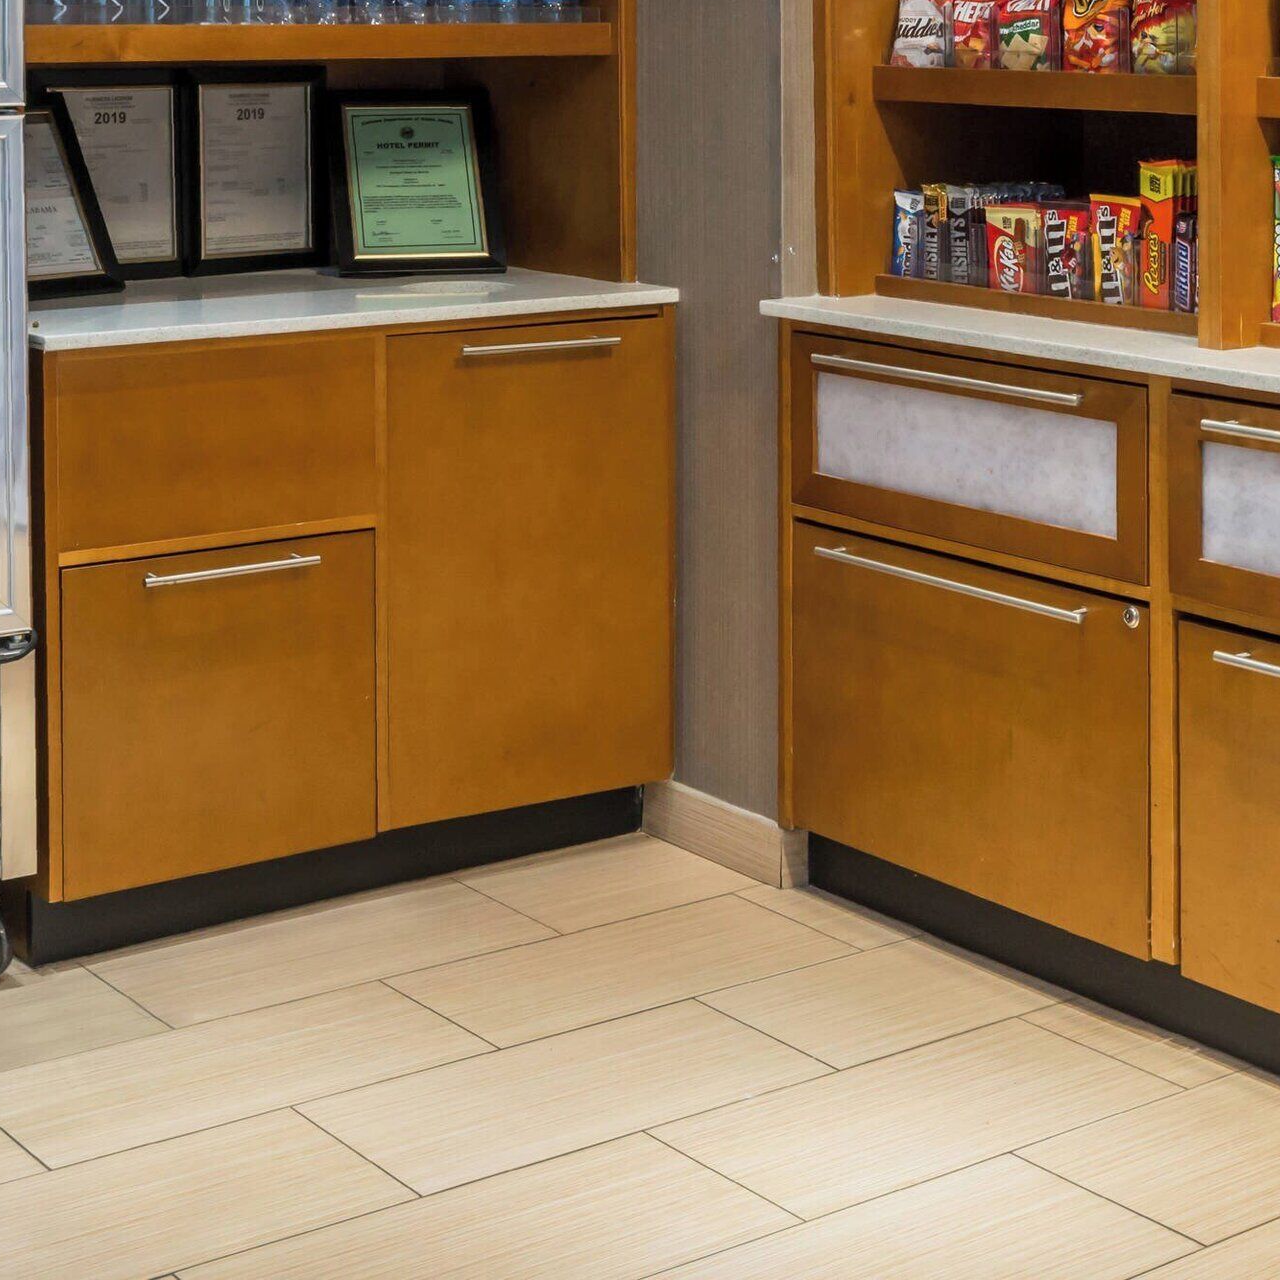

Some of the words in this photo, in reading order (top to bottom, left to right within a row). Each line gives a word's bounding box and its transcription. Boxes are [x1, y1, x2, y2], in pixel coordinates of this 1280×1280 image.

[93, 110, 127, 125] 2019
[235, 107, 265, 121] 2019
[376, 142, 406, 150] HOTEL
[407, 141, 440, 149] PERMIT
